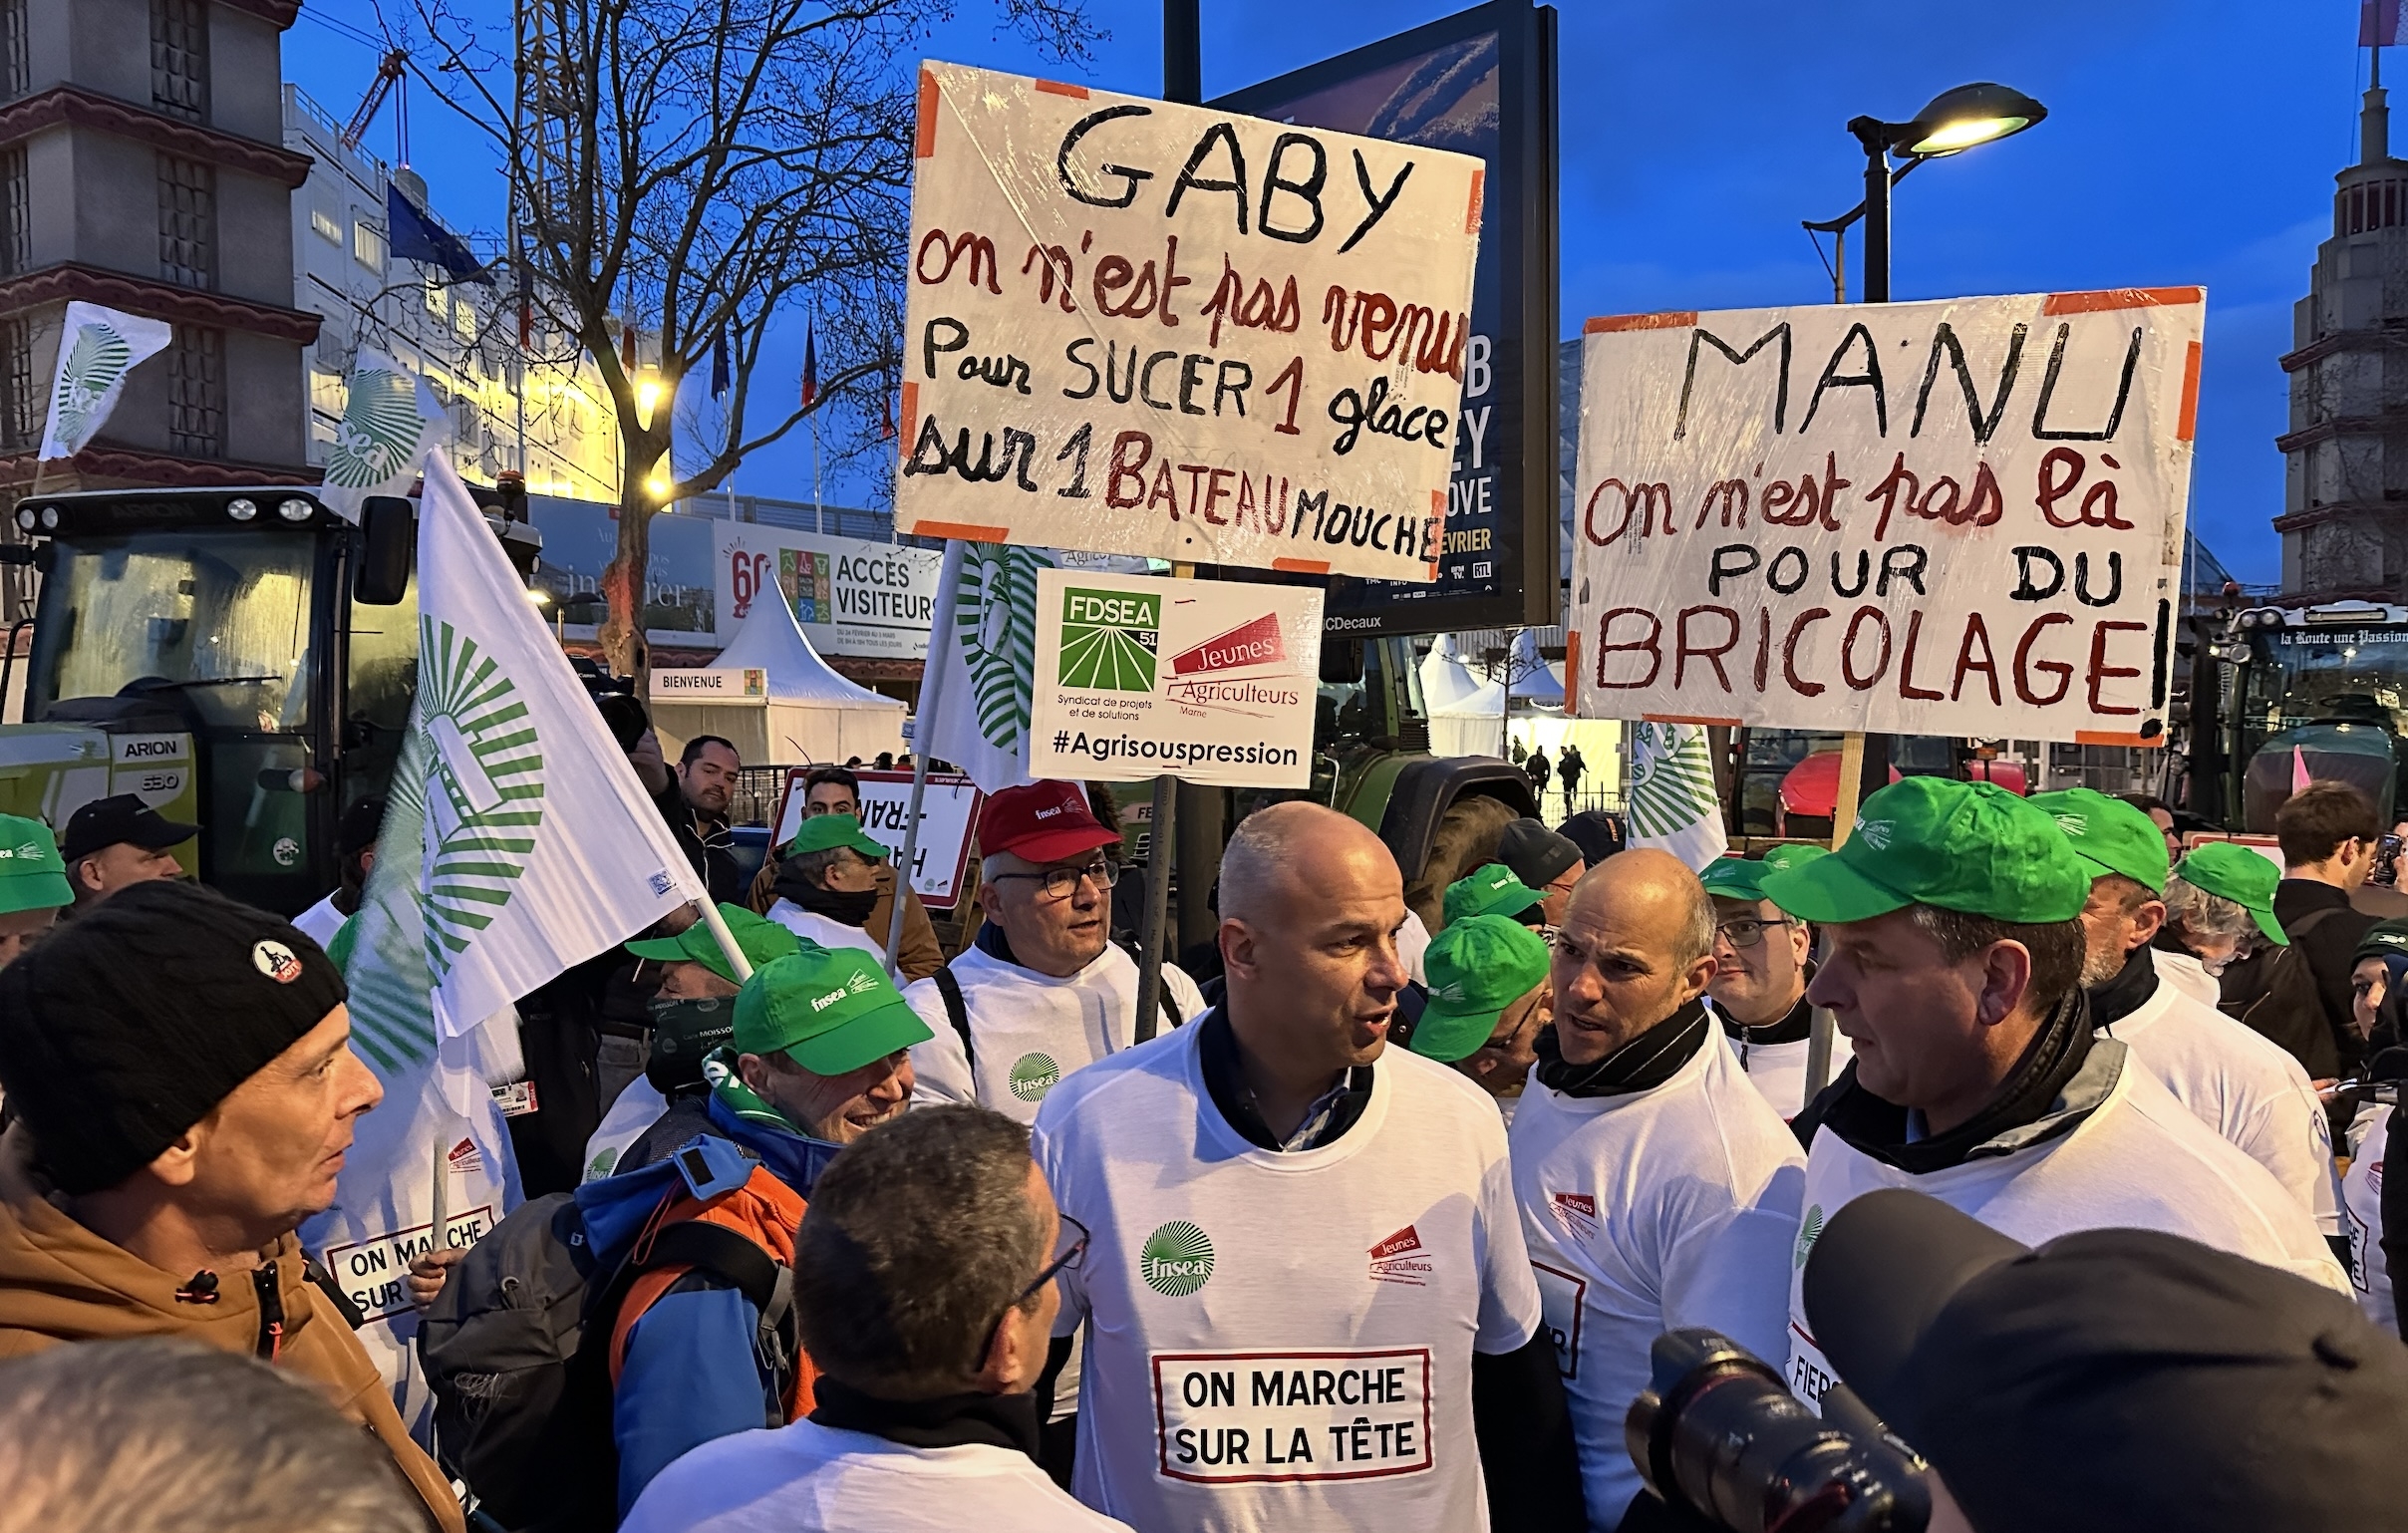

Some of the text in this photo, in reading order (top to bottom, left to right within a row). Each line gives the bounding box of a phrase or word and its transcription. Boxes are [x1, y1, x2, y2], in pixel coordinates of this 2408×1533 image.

[1057, 105, 1414, 253] GABY
[916, 229, 1469, 383] on n'est pas venu
[923, 317, 1448, 455] Pour SUCER 1 glace
[1673, 321, 2143, 446] MANU
[903, 414, 1442, 563] sur 1 BATEAU MOUCHE
[1694, 450, 1852, 533] n'est
[1866, 452, 2004, 542] pas
[2036, 447, 2135, 531] là
[836, 552, 910, 588] ACCÈS
[1475, 563, 1491, 577] RTL
[1708, 543, 2122, 607] POUR DU
[836, 586, 937, 621] VISITEUR
[1069, 595, 1154, 626] FDSEA
[1139, 632, 1157, 647] 51
[2333, 633, 2354, 644] une
[1197, 637, 1275, 671] Jeunes
[663, 676, 723, 689] BIENVENUE
[1181, 681, 1299, 706] Agriculteurs
[1057, 694, 1152, 711] Syndicat de projets
[1069, 708, 1139, 721] et de solutions
[1179, 706, 1207, 719] Marne
[125, 741, 177, 758] ARION
[1053, 730, 1297, 766] #Agrisouspression
[1035, 805, 1061, 820] fnsea
[810, 988, 847, 1013] fnsea
[699, 1026, 734, 1038] MOISSO
[1017, 1075, 1054, 1093] fnsea
[1565, 1194, 1594, 1213] Jeunes
[351, 1219, 482, 1277] ON MACHE
[1381, 1237, 1416, 1256] Jeunes
[1151, 1257, 1206, 1279] fnsea
[1376, 1261, 1432, 1273] Agriculteurs
[352, 1280, 405, 1313] SUR
[1183, 1368, 1405, 1408] ON MARCHE
[1176, 1417, 1416, 1465] SUR LA TÊTE
